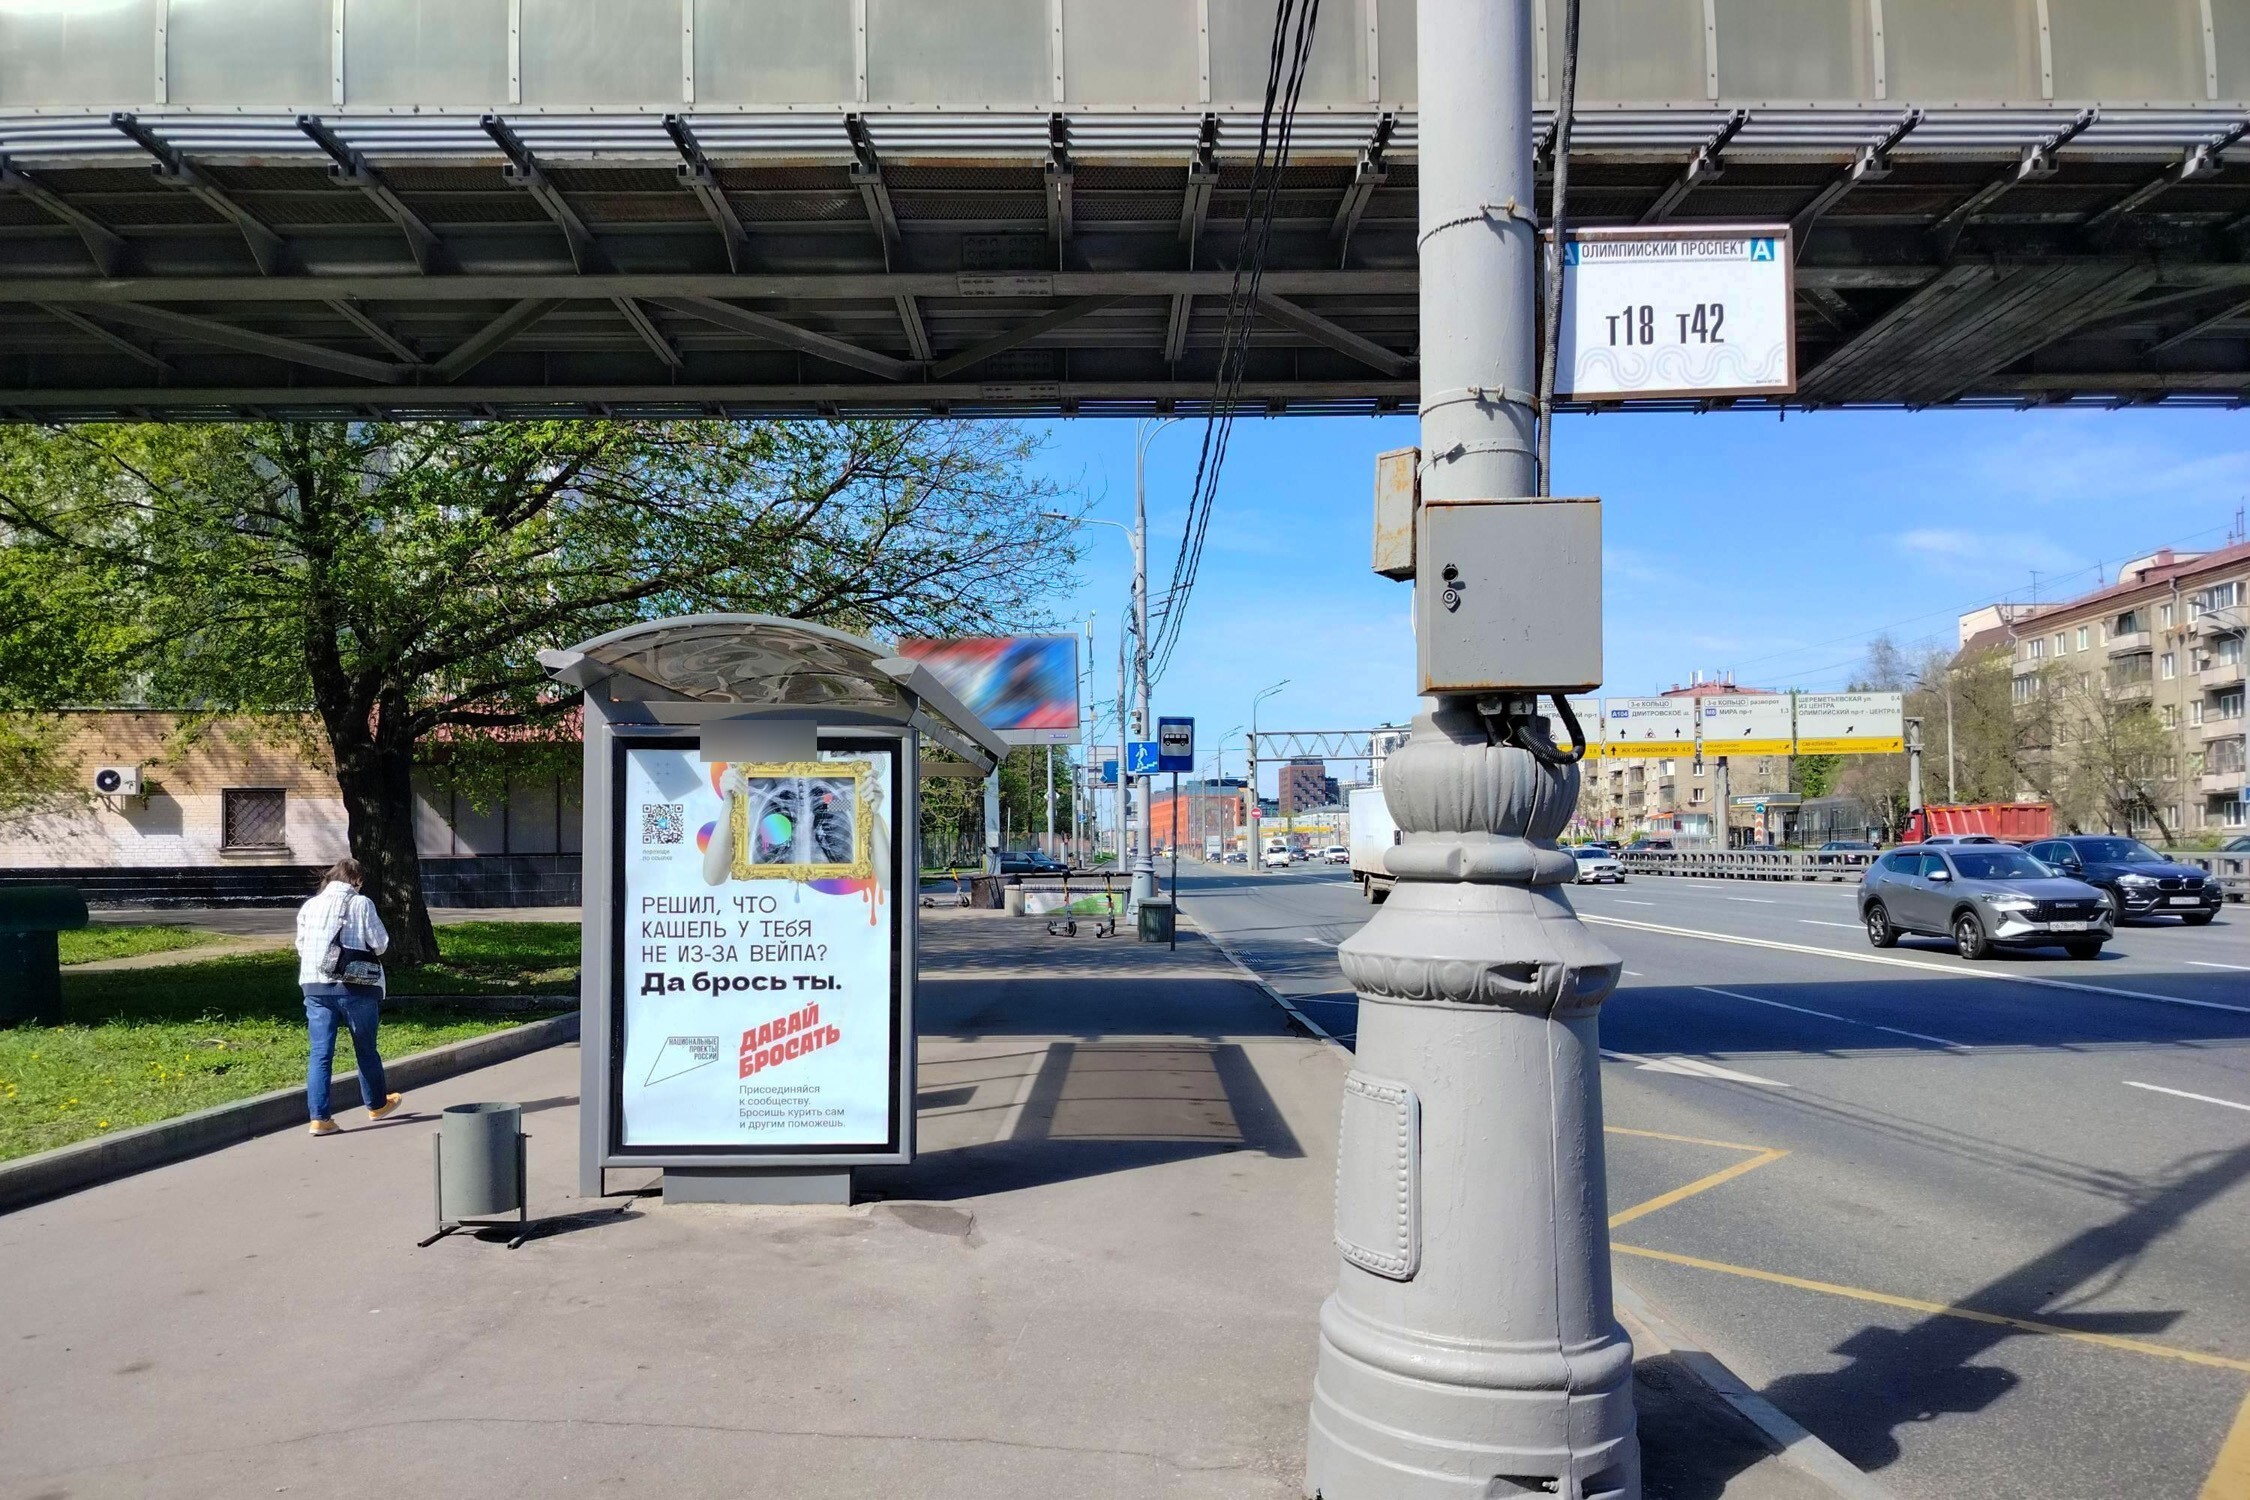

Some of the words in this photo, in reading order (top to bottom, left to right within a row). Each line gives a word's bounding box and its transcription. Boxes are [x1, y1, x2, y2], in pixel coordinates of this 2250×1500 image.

[1680, 240, 1746, 256] ПРОСПЕКТ
[1641, 700, 1670, 708] КОЛЬЦО
[1718, 699, 1746, 707] КОЛЬЦО
[1798, 695, 1863, 703] ШЕРЕМЕТЬЕВСКАЯ
[1808, 702, 1835, 710] ЦЕНТРА
[1631, 710, 1682, 718] ДМИТРОВСКОЕ
[1798, 708, 1850, 716] ОЛИМПИЙСКИЙ
[642, 896, 722, 916] РЕШИЛ,
[732, 895, 777, 914] ЧТО
[642, 920, 727, 939] КАШЕЛЬ
[738, 920, 750, 938] У
[642, 945, 667, 963] НЕ
[677, 944, 739, 963] ИЗ-ЗА
[750, 940, 828, 962] ВЕЙПА?
[640, 972, 686, 996] Да
[691, 971, 787, 997] брось
[792, 975, 842, 990] ты.
[739, 1000, 819, 1057] ДАВАЙ
[668, 1038, 717, 1046] НАЦИОНАЛЬНЫЕ
[689, 1045, 717, 1053] ПРОЕКТЫ
[739, 1023, 841, 1080] БРОСАТЬ
[693, 1052, 717, 1060] РОССИИ
[739, 1084, 821, 1096] Присоединяйся
[739, 1098, 746, 1106] к
[747, 1096, 811, 1107] сообществу.
[739, 1108, 786, 1119] Бросишь
[787, 1109, 823, 1119] курить
[824, 1108, 845, 1117] сам
[739, 1121, 746, 1129] и
[748, 1120, 786, 1130] другим
[787, 1119, 846, 1128] поможешь.
